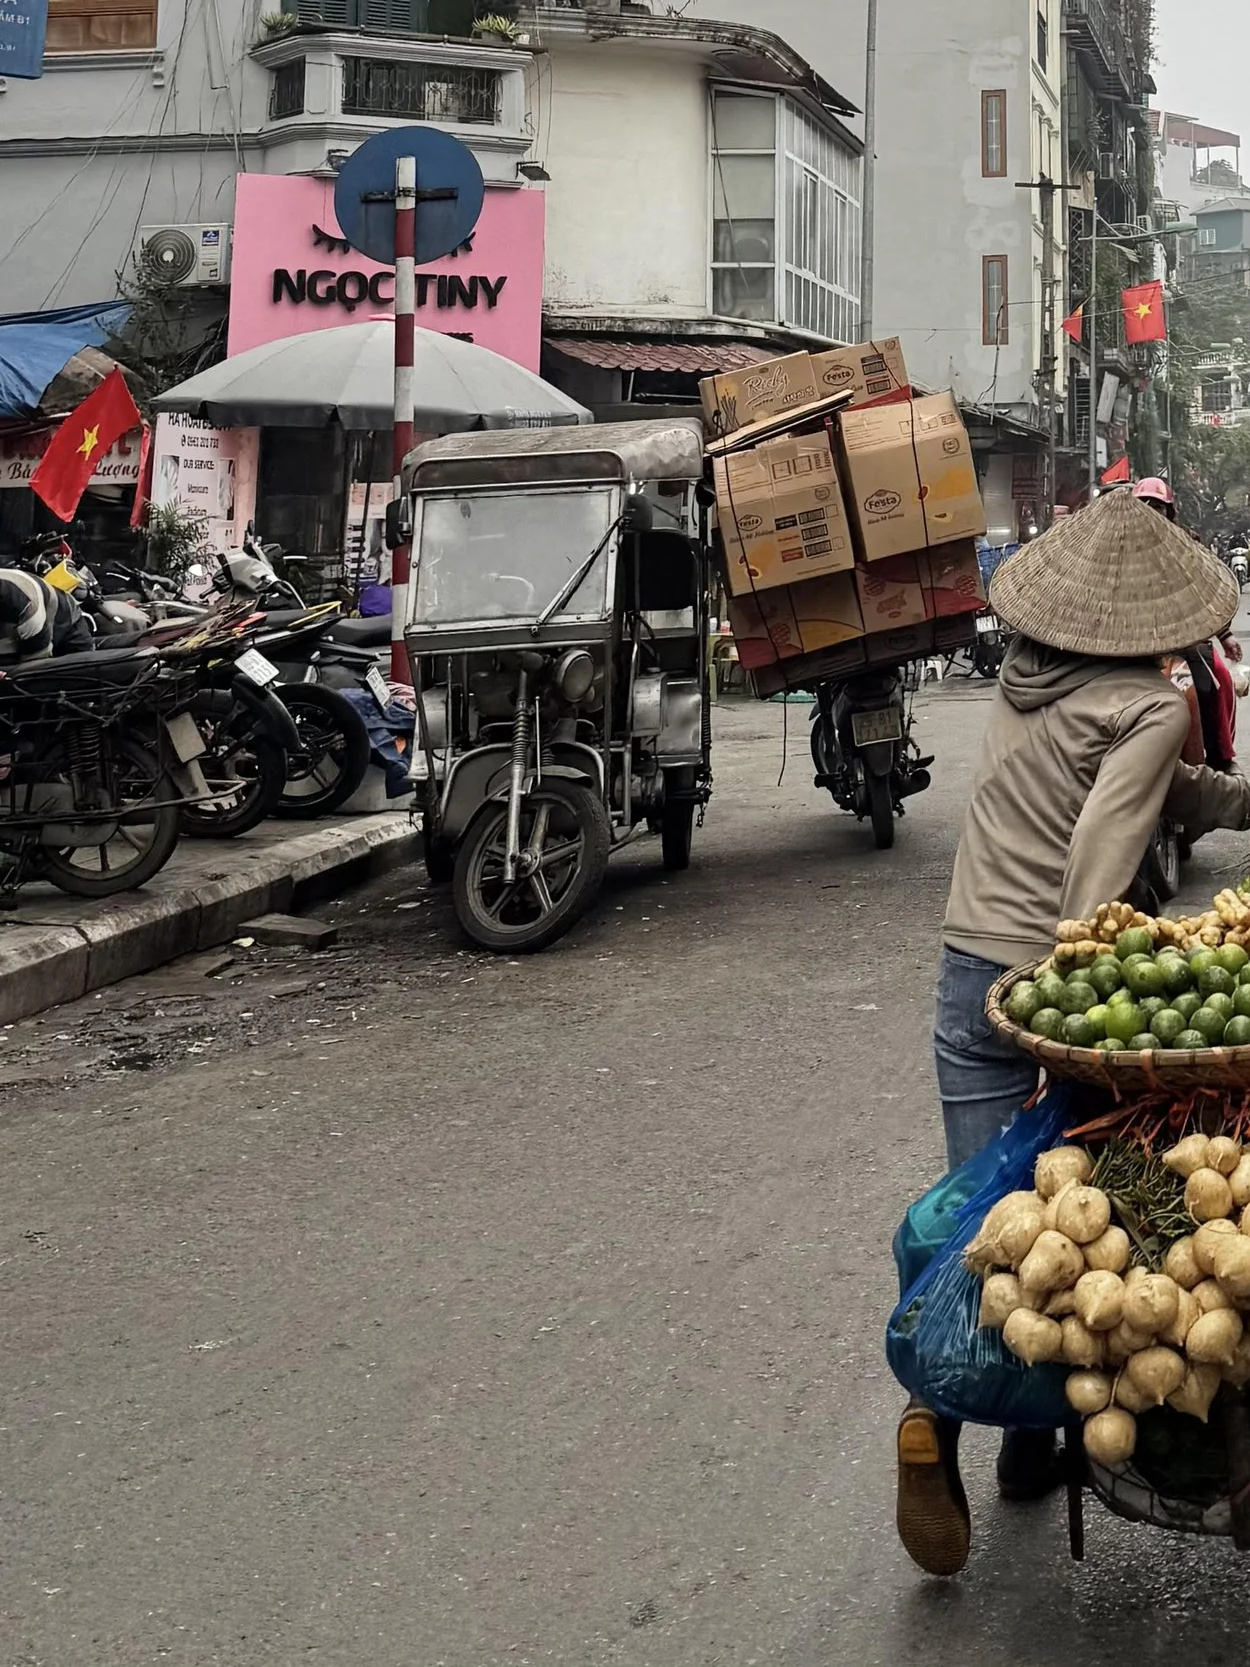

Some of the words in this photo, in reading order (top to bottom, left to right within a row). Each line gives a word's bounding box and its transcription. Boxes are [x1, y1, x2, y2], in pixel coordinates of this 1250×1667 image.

[273, 269, 395, 312] NGỌC
[415, 273, 507, 309] TINY
[868, 496, 897, 510] Festa
